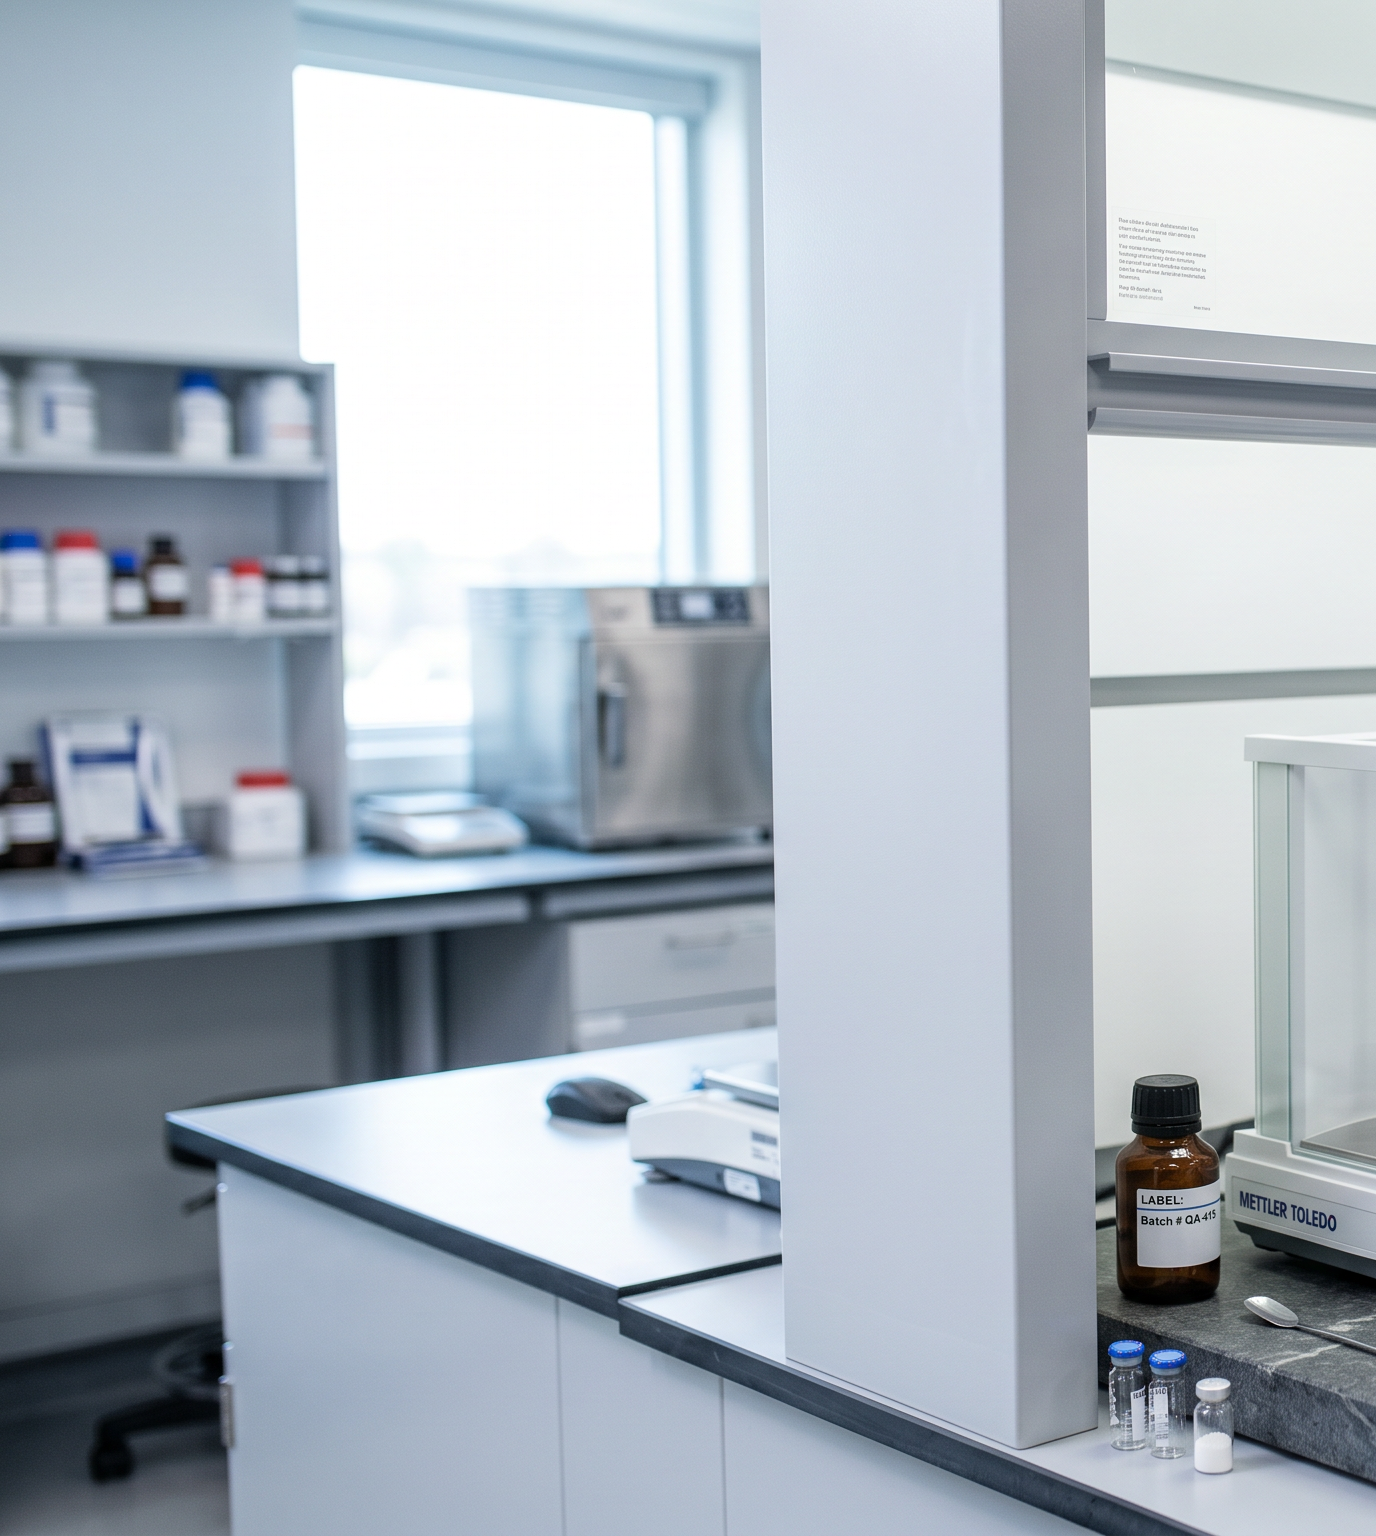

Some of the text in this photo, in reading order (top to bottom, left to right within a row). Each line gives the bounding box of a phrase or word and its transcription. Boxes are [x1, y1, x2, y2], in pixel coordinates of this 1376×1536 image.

[1141, 1194, 1184, 1205] LABEL:
[1141, 1209, 1217, 1226] Batch # QA-415
[1239, 1190, 1337, 1232] METTLER TOLEDO
